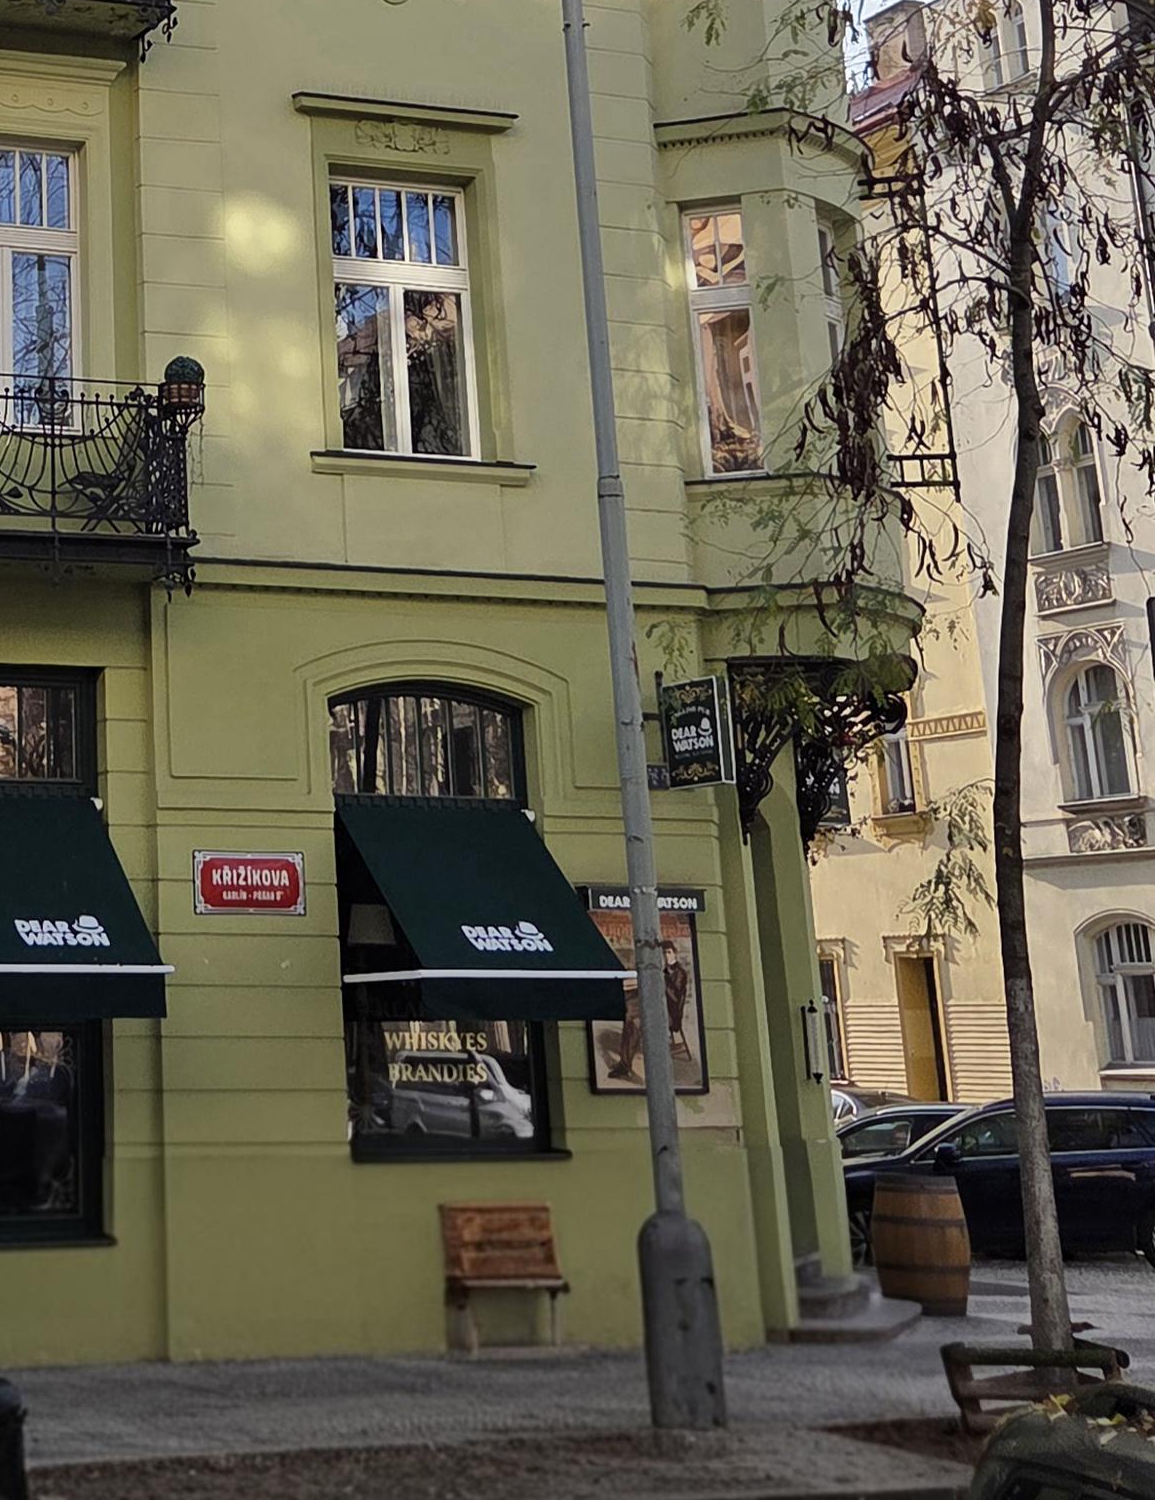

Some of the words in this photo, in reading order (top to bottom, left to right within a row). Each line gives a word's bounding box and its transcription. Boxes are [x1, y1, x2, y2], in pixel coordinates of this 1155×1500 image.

[671, 725, 697, 740] DEAR
[673, 735, 714, 753] WATSON
[211, 865, 290, 887] KŘIŽÍKOVA
[599, 895, 631, 908] DEAR
[657, 897, 698, 910] ATSON
[14, 919, 71, 933] DEAR
[460, 925, 515, 939] DEAR
[19, 931, 111, 946] WATSON
[468, 937, 554, 952] WATSON
[384, 1031, 488, 1052] WHISKYES
[388, 1062, 488, 1084] BRANDIES
